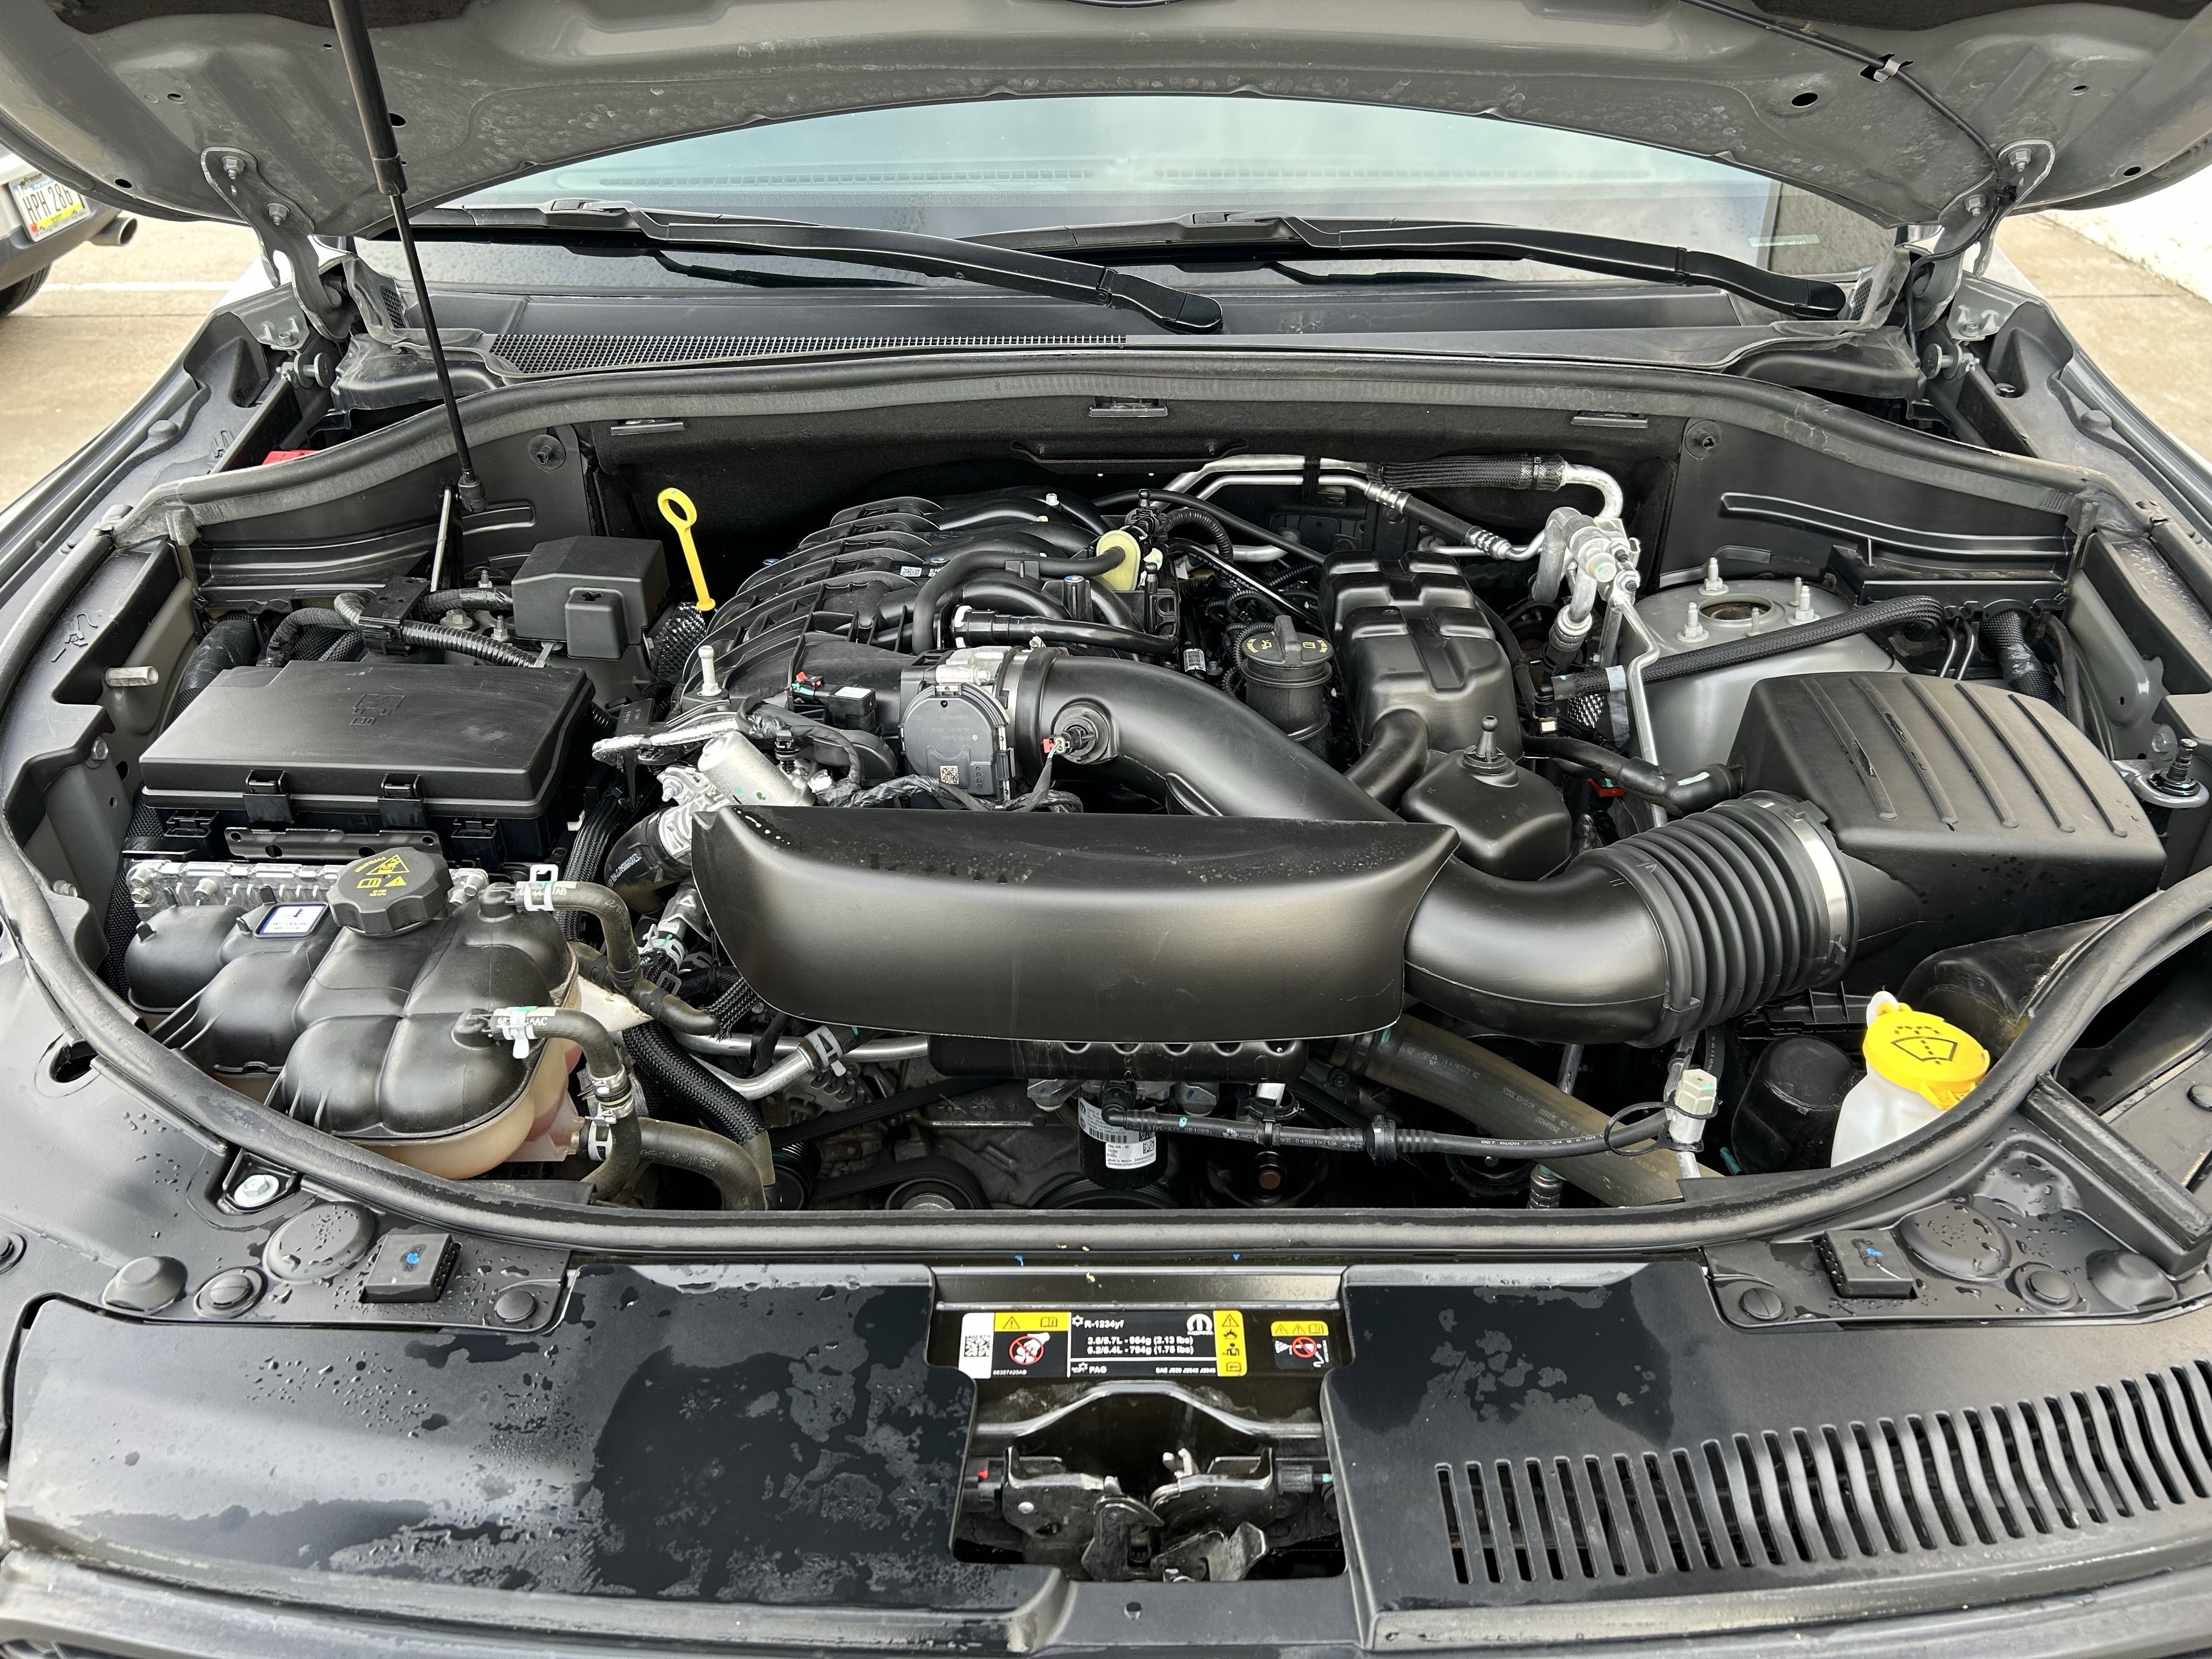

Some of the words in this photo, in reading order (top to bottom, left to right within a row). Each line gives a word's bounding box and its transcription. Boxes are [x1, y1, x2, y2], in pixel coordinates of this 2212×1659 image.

[22, 190, 51, 223] HPH
[48, 183, 74, 212] 286
[1084, 1319, 1124, 1330] R-1234yf
[1176, 1336, 1194, 1345] lbs)
[1176, 1346, 1194, 1355] lbs)
